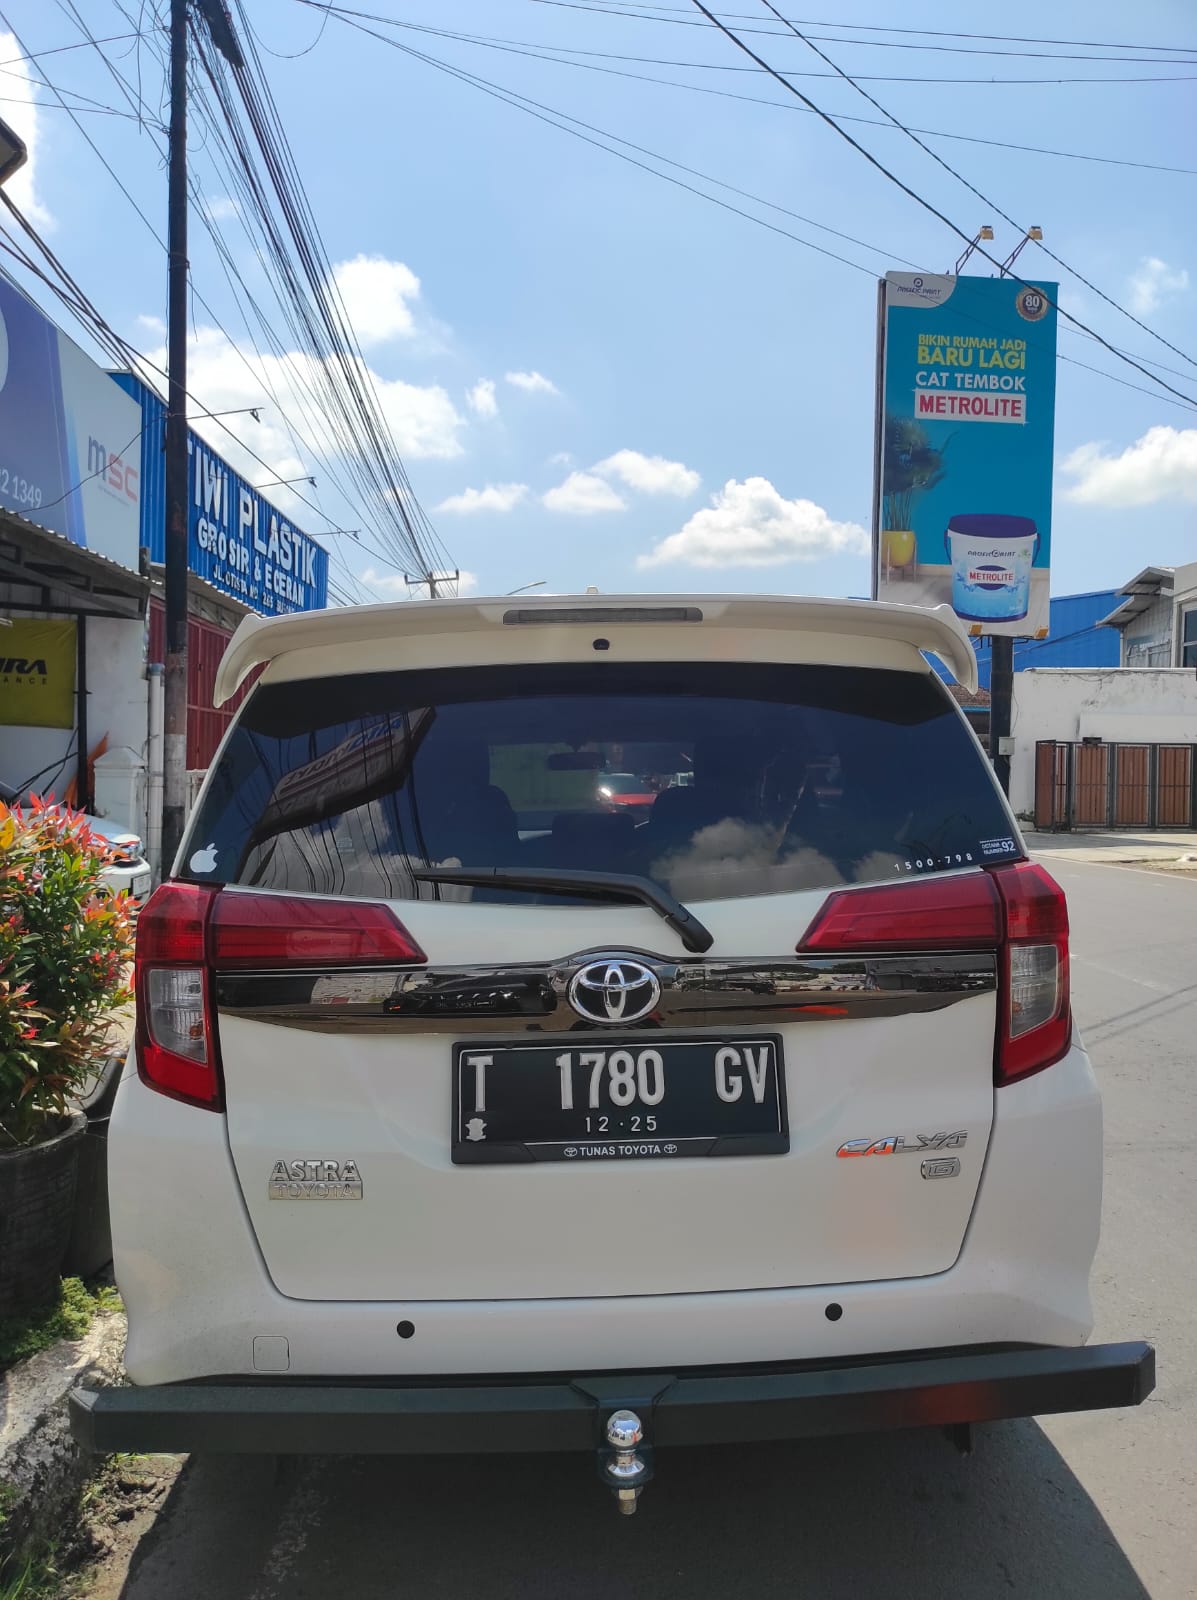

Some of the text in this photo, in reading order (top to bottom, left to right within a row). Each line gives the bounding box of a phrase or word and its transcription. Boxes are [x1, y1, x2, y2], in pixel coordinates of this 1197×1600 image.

[1025, 295, 1040, 307] 80
[918, 334, 1027, 350] BIKIN RUMAH JADI
[917, 347, 1025, 370] BARU LAGI
[915, 371, 1026, 391] CAT TEMBOK
[919, 395, 1022, 417] METROLITE
[12, 475, 42, 509] 1349
[240, 486, 317, 589] PLASTIK
[254, 556, 262, 581] &
[969, 572, 1014, 582] METROLITE
[1001, 840, 1017, 853] 92
[467, 1046, 769, 1112] T 1780 GV
[580, 1144, 661, 1157] TUNAS TOYOTA
[836, 1129, 968, 1158] CALYA
[269, 1160, 362, 1182] ASTRA
[273, 1183, 356, 1199] TOYOTA
